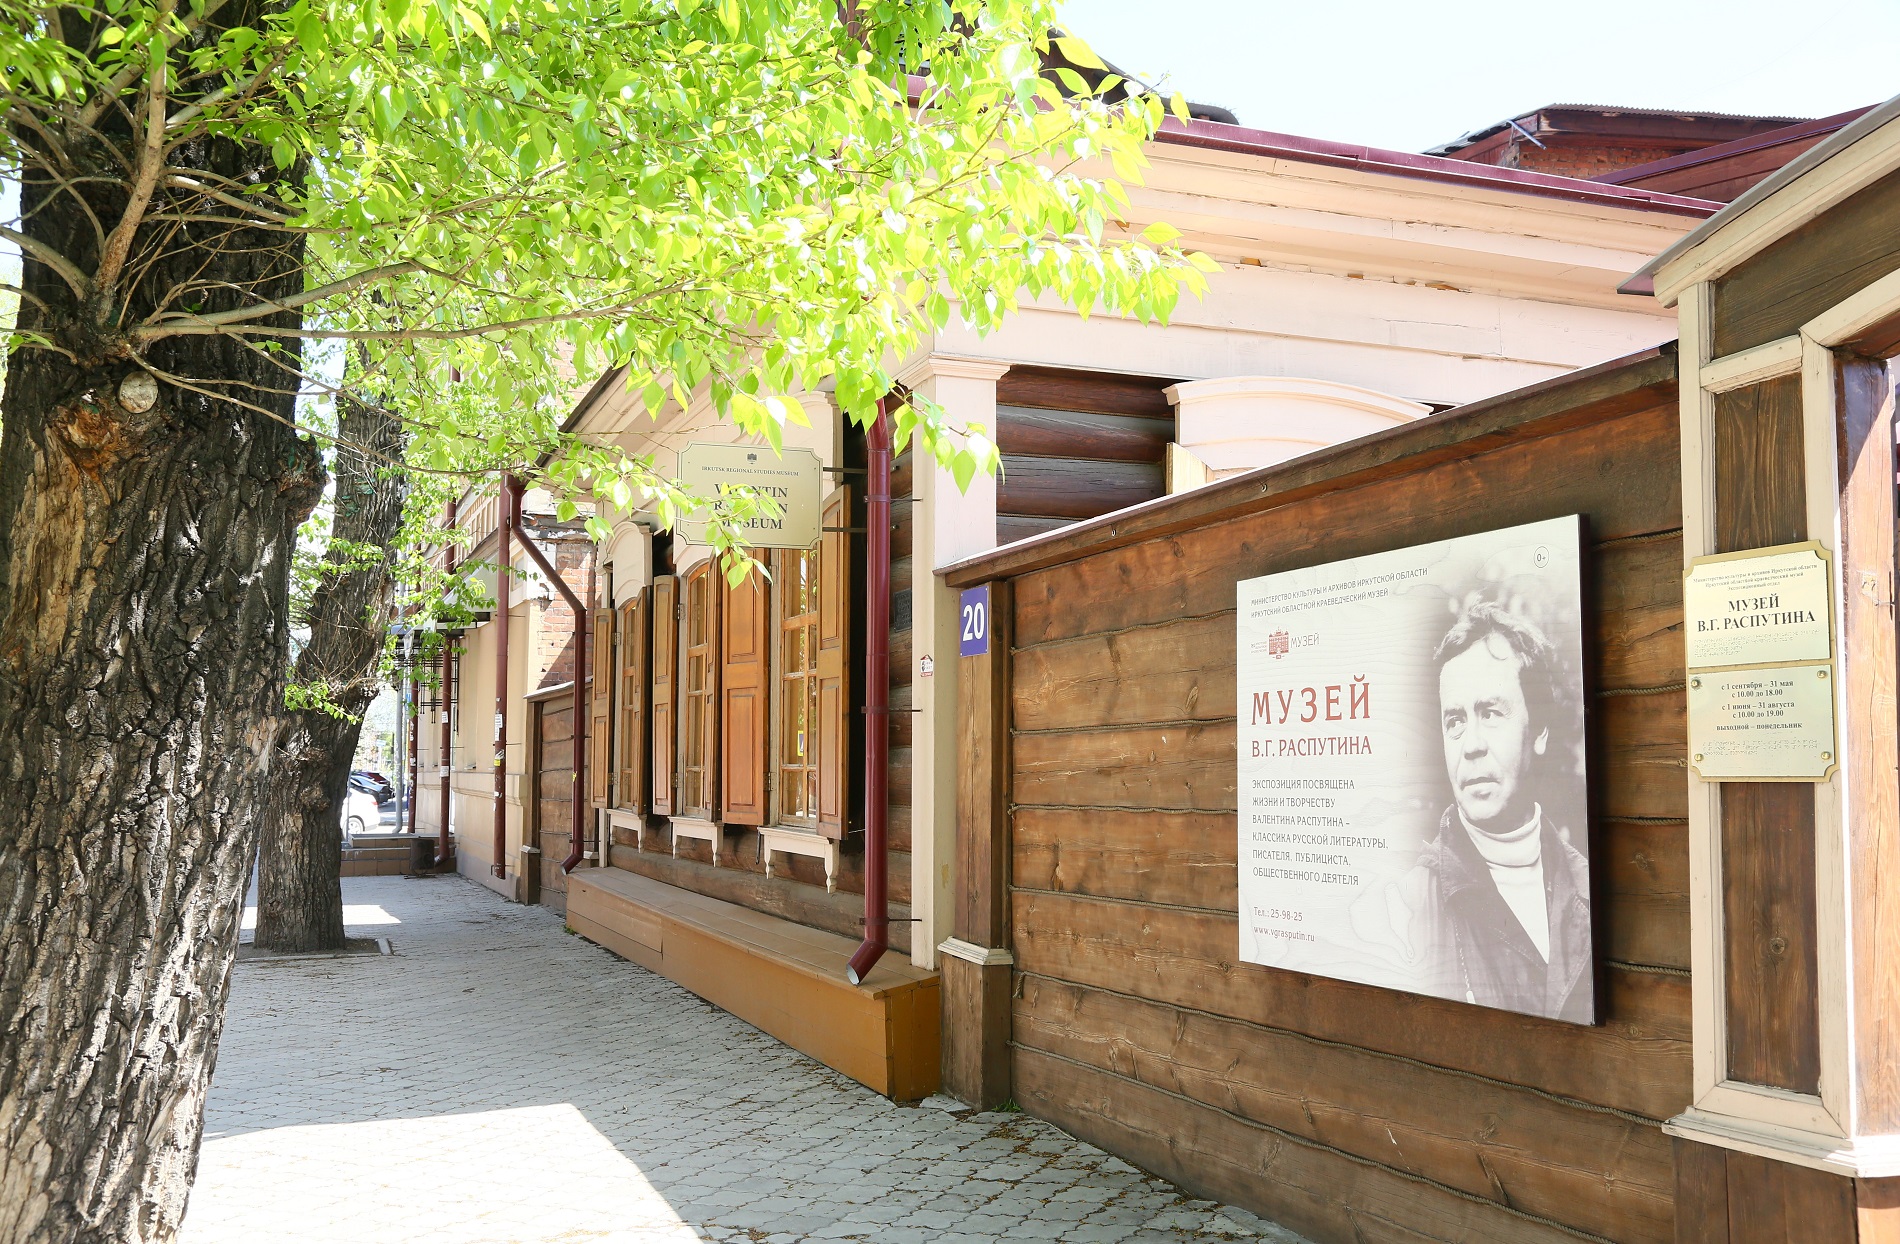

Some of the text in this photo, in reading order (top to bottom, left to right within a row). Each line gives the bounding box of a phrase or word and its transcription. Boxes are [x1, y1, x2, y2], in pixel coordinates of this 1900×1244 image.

[721, 517, 783, 530] MSEUM
[1250, 593, 1292, 606] МИНИСТЕРСТВО
[1292, 587, 1322, 599] КУЛЬТУРЫ
[1328, 580, 1357, 592] АРХИВОВ
[1357, 572, 1395, 587] ИРКУТСКОЙ
[1395, 567, 1428, 581] ОБЛАСТИ
[1251, 588, 1389, 618] ИРКУТСКИЙ ОБЛАСТНОЙ КРАЕВЕДЧЕСКИЙ МУЗЕЙ
[1728, 593, 1780, 612] МУЗЕЙ
[963, 602, 984, 641] 20
[1697, 610, 1816, 632] В.Г. РАСПУТИНА
[1290, 632, 1320, 648] МУЗЕЙ
[1731, 681, 1763, 691] сентября
[1737, 690, 1754, 698] 10.00
[1765, 688, 1783, 697] 18.00
[1252, 674, 1370, 725] МУЗЕЙ
[1767, 701, 1795, 710] августа
[1766, 709, 1784, 717] 19.00
[1716, 723, 1750, 731] выходной
[1756, 722, 1803, 730] понедельник
[1251, 735, 1373, 758] В.Г. РАСПУТИНА
[1252, 779, 1355, 791] ЭКСПОЗИЦИЯ ПОСВЯЩЕНА
[1252, 797, 1336, 808] ЖИЗНИ И ТВОРЧЕСТВУ
[1252, 814, 1296, 825] ВАЛЕНТИНА
[1297, 816, 1344, 827] РАСПУТИНА
[1252, 831, 1291, 843] КЛАССИКА
[1292, 833, 1328, 846] РУССКОЙ
[1252, 866, 1359, 886] ОБЩЕСТВЕННОГО ДЕЯТЕЛЯ
[1270, 908, 1303, 922] 25-98-25
[1253, 926, 1315, 942] www.vgrasputin.ru
